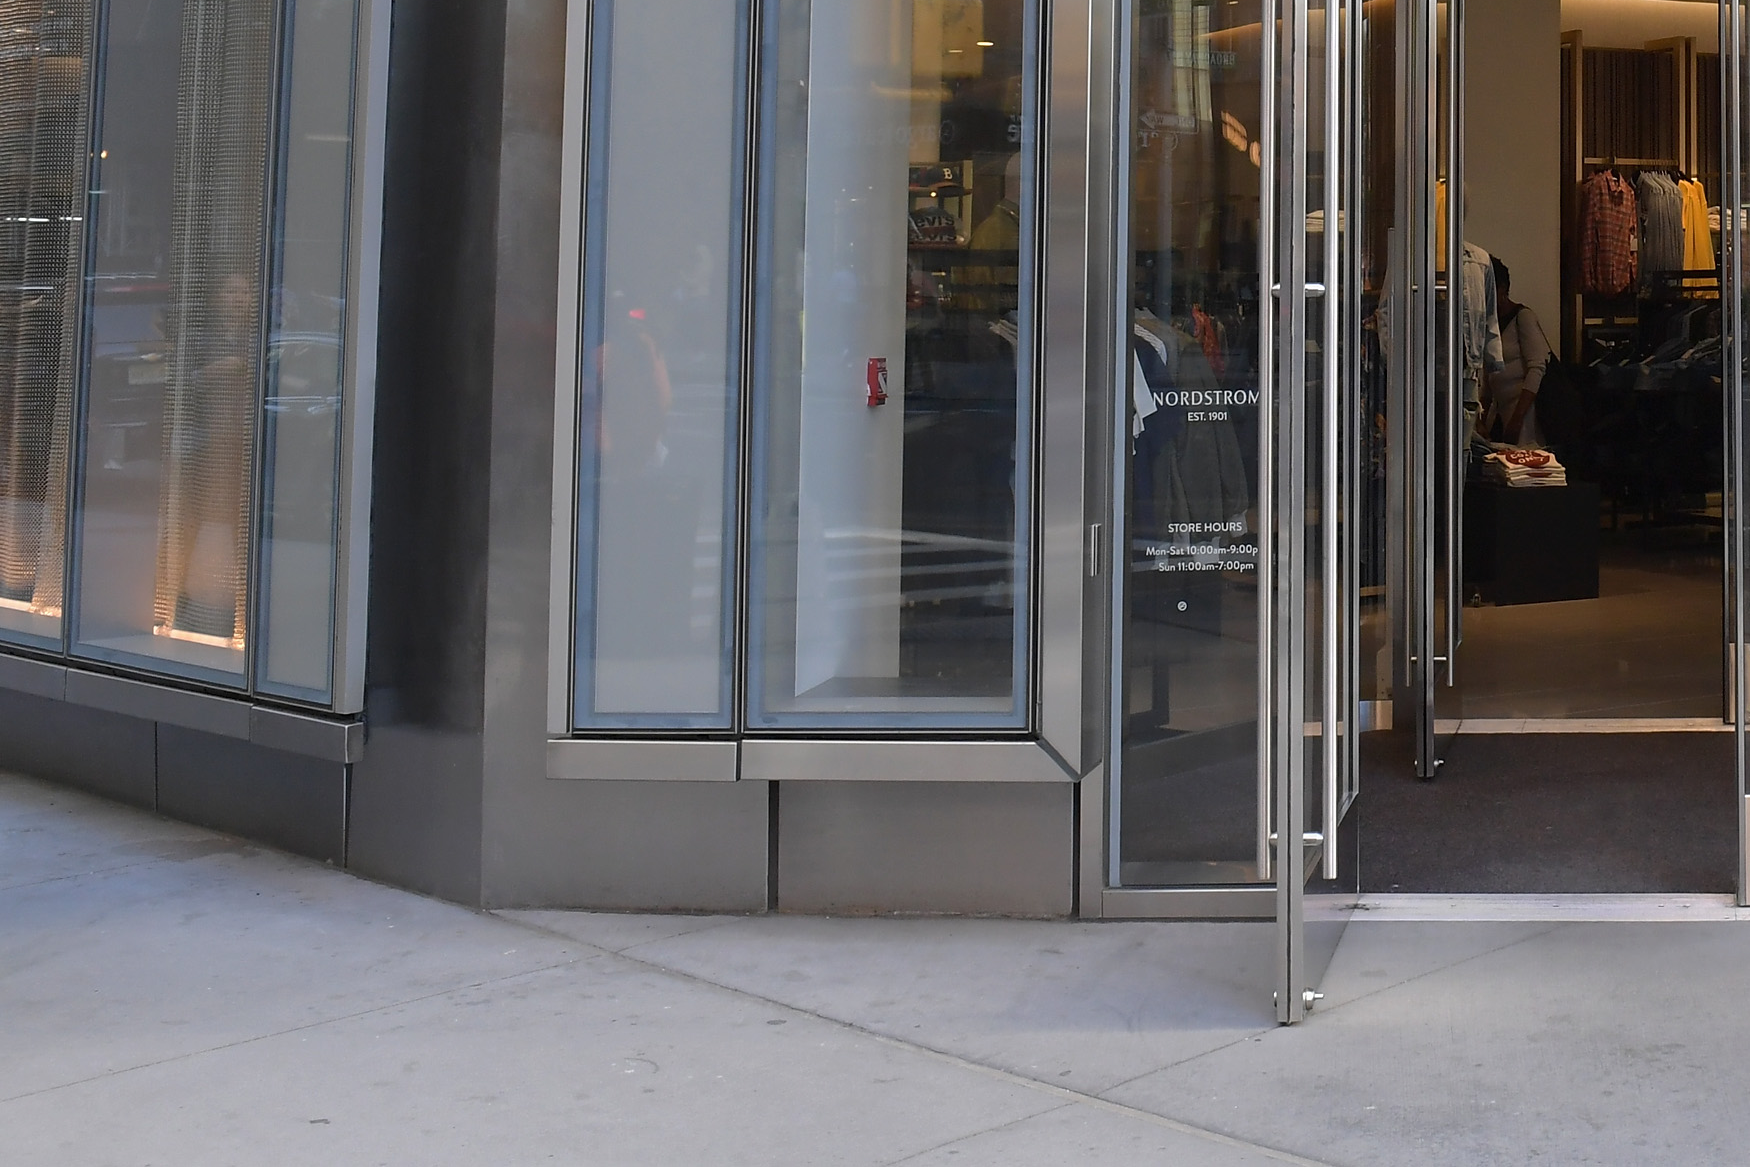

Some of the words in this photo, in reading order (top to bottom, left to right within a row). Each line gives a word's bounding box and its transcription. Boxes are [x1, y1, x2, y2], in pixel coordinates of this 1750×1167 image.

[942, 167, 953, 180] B
[1152, 389, 1260, 407] NORDSTROM
[1187, 411, 1207, 422] EST.
[1208, 411, 1228, 422] 1901
[1167, 522, 1202, 533] STORE
[1204, 521, 1243, 532] HOURS
[1145, 545, 1185, 556] Mon-Sat
[1158, 562, 1176, 572] Sun
[1177, 561, 1255, 573] 11:00am-7:00pm
